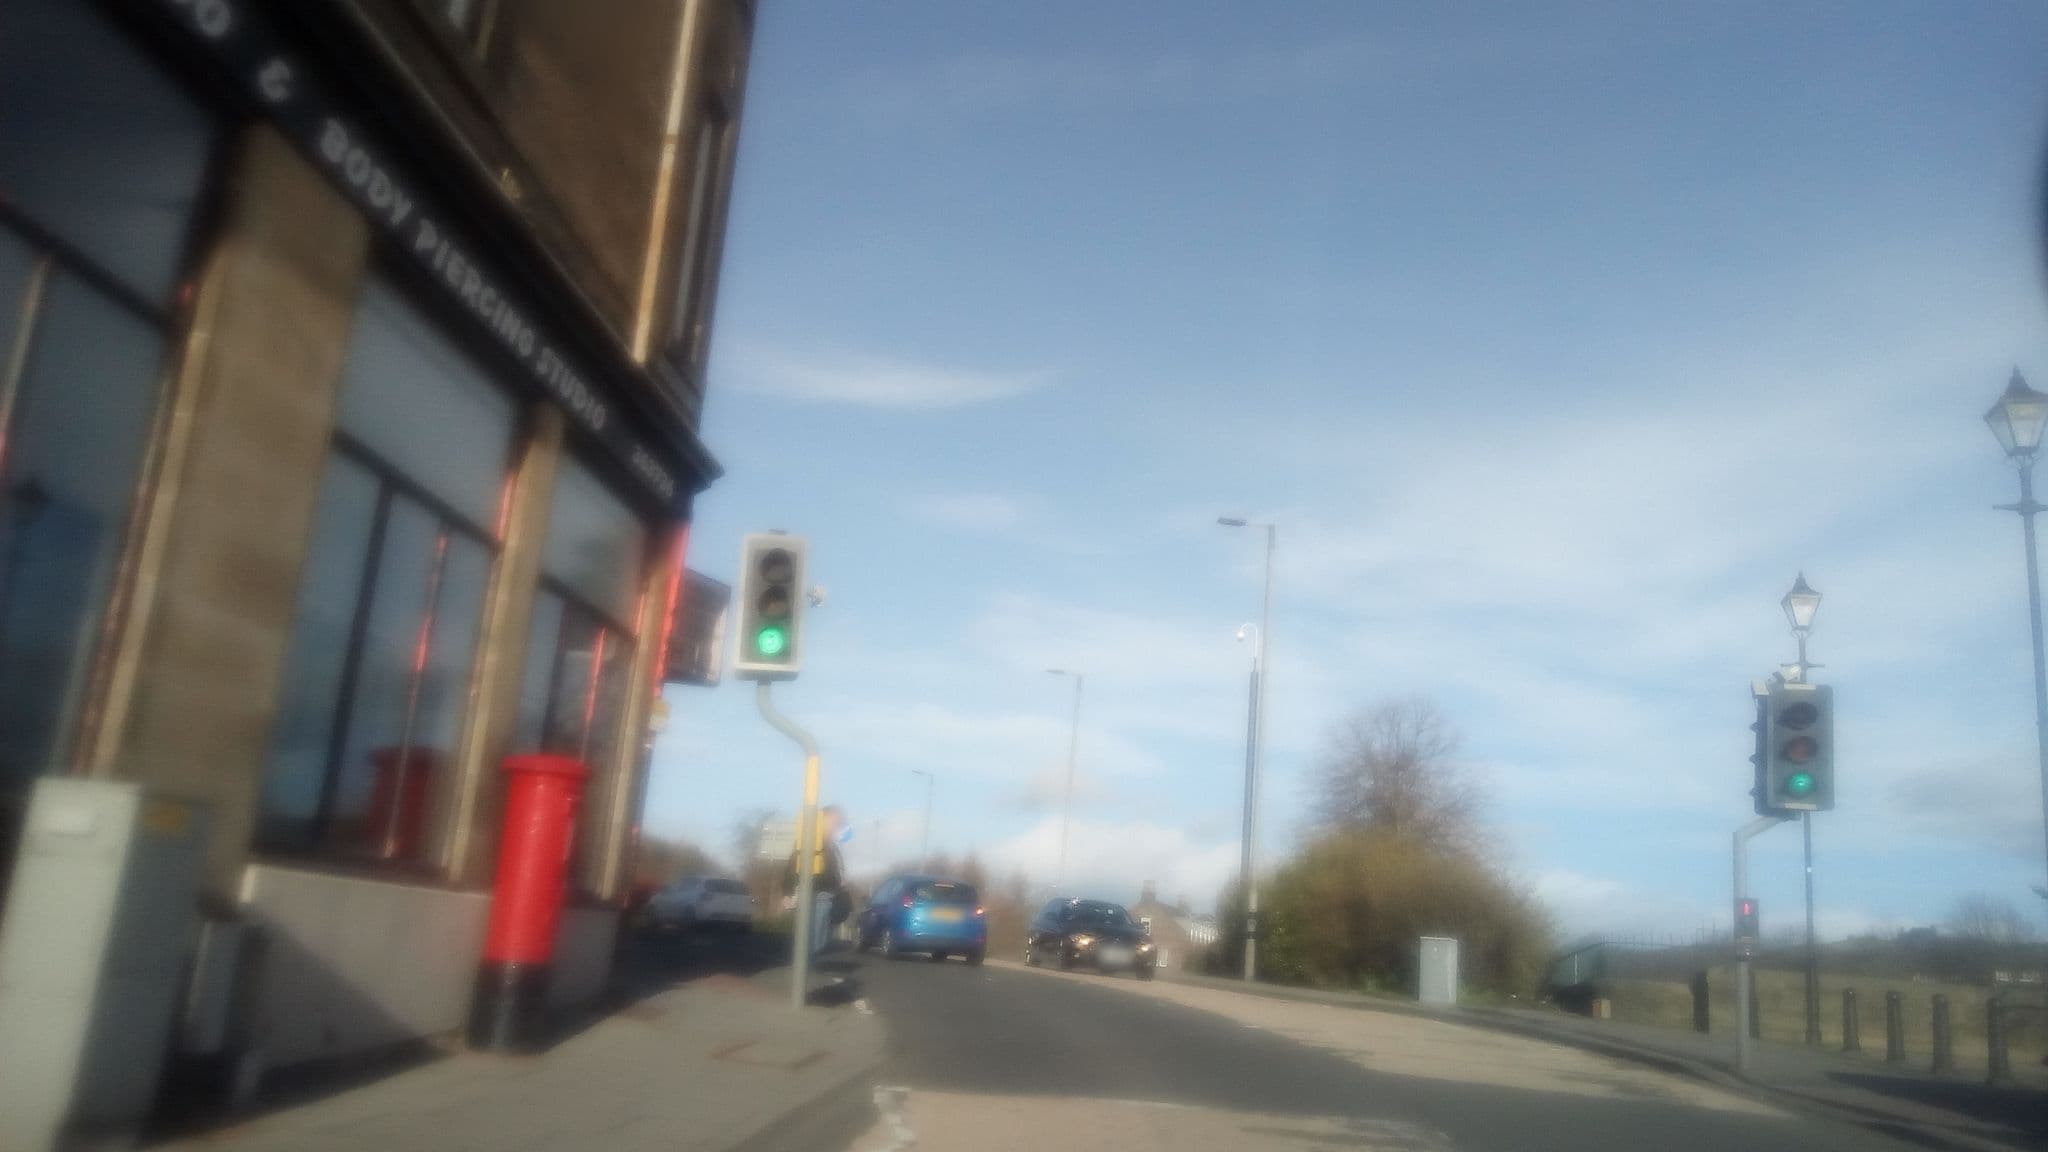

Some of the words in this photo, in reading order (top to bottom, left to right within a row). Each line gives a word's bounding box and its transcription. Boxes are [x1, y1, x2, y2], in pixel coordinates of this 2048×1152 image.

[320, 116, 412, 227] BODY
[415, 218, 536, 358] PIERCING
[535, 345, 607, 431] STUDIO
